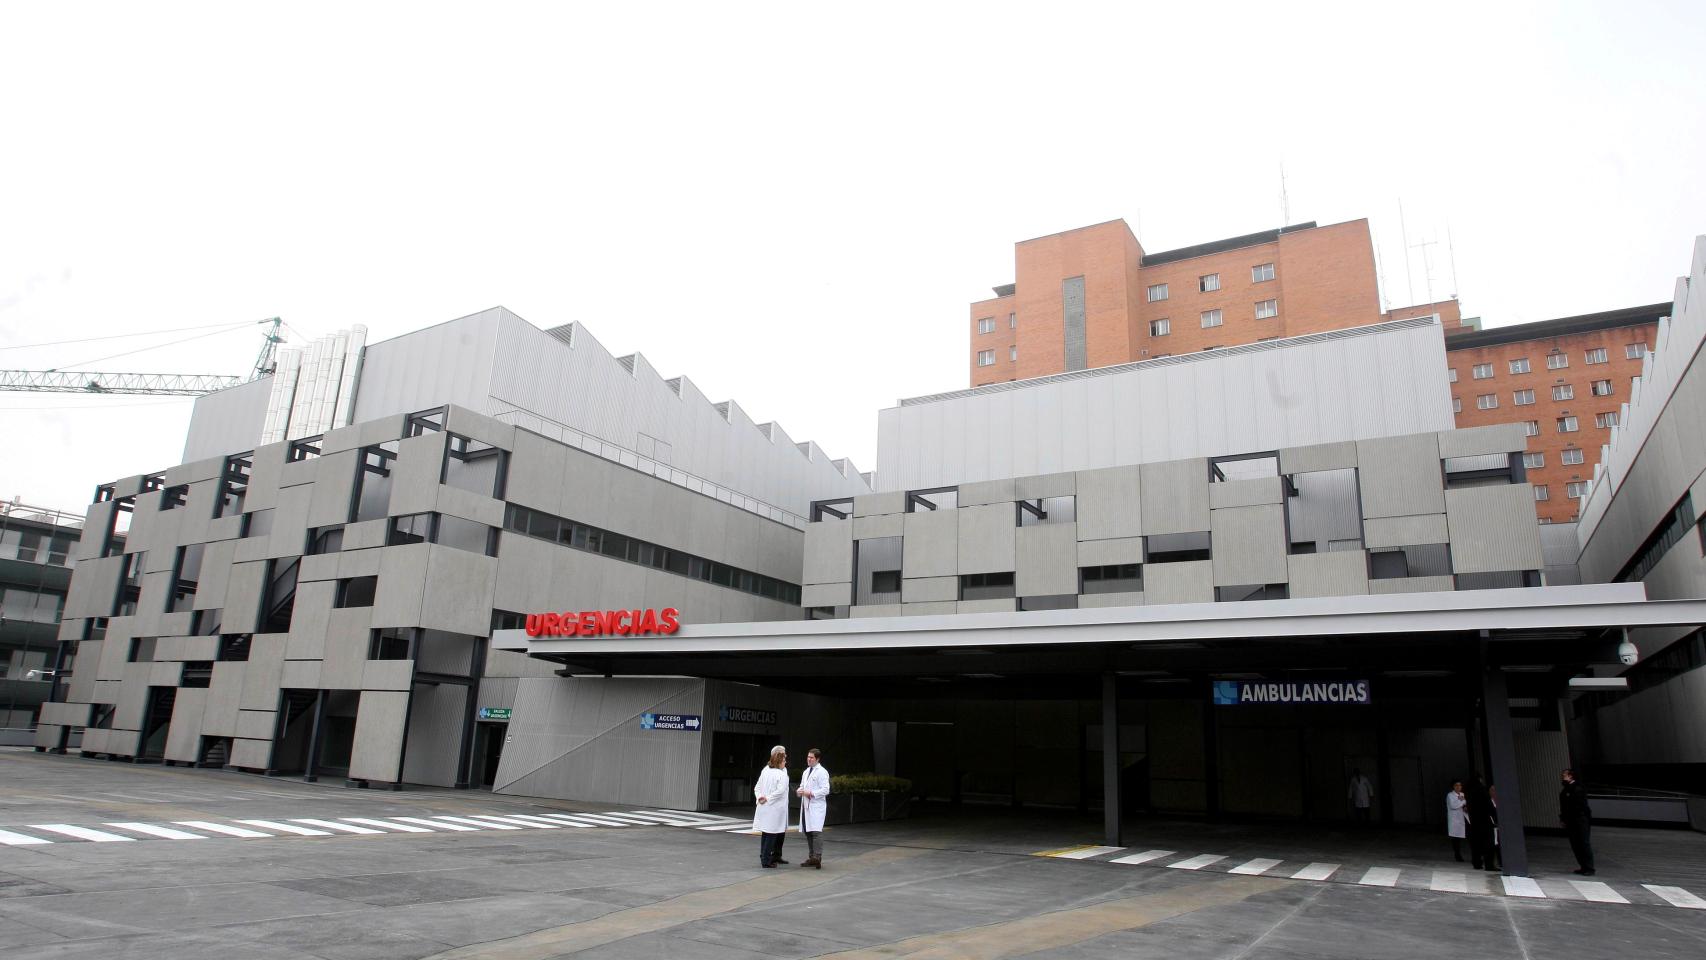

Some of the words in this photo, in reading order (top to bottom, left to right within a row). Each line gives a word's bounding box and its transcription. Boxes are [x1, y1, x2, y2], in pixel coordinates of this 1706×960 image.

[525, 607, 680, 637] URGENCIAS
[1241, 682, 1367, 702] AMBULANCIAS
[729, 708, 776, 724] URGENCIAS
